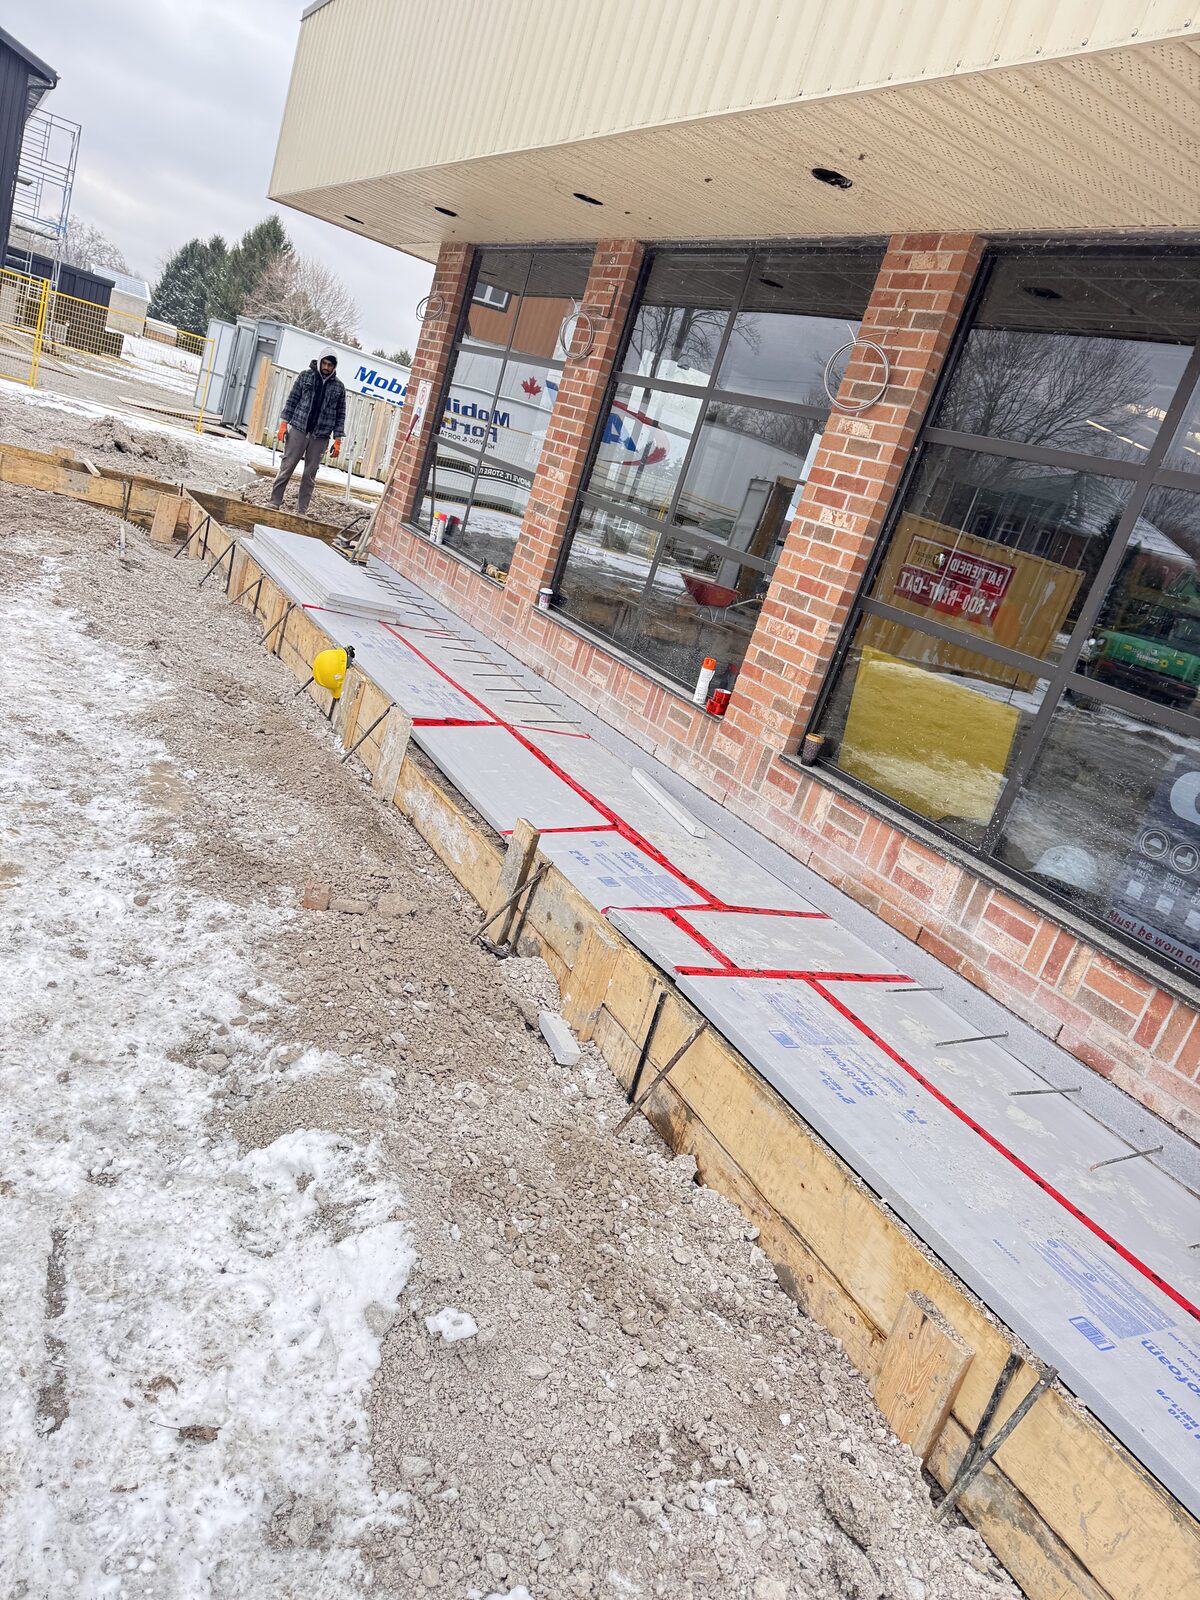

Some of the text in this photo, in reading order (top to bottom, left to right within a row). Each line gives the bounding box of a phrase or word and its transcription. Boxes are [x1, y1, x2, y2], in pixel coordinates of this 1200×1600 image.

[1107, 909, 1137, 932] Must
[1137, 925, 1153, 941] be
[1153, 936, 1184, 959] worn
[822, 1047, 878, 1096] Styrofoam
[1141, 1340, 1200, 1397] ofoam
